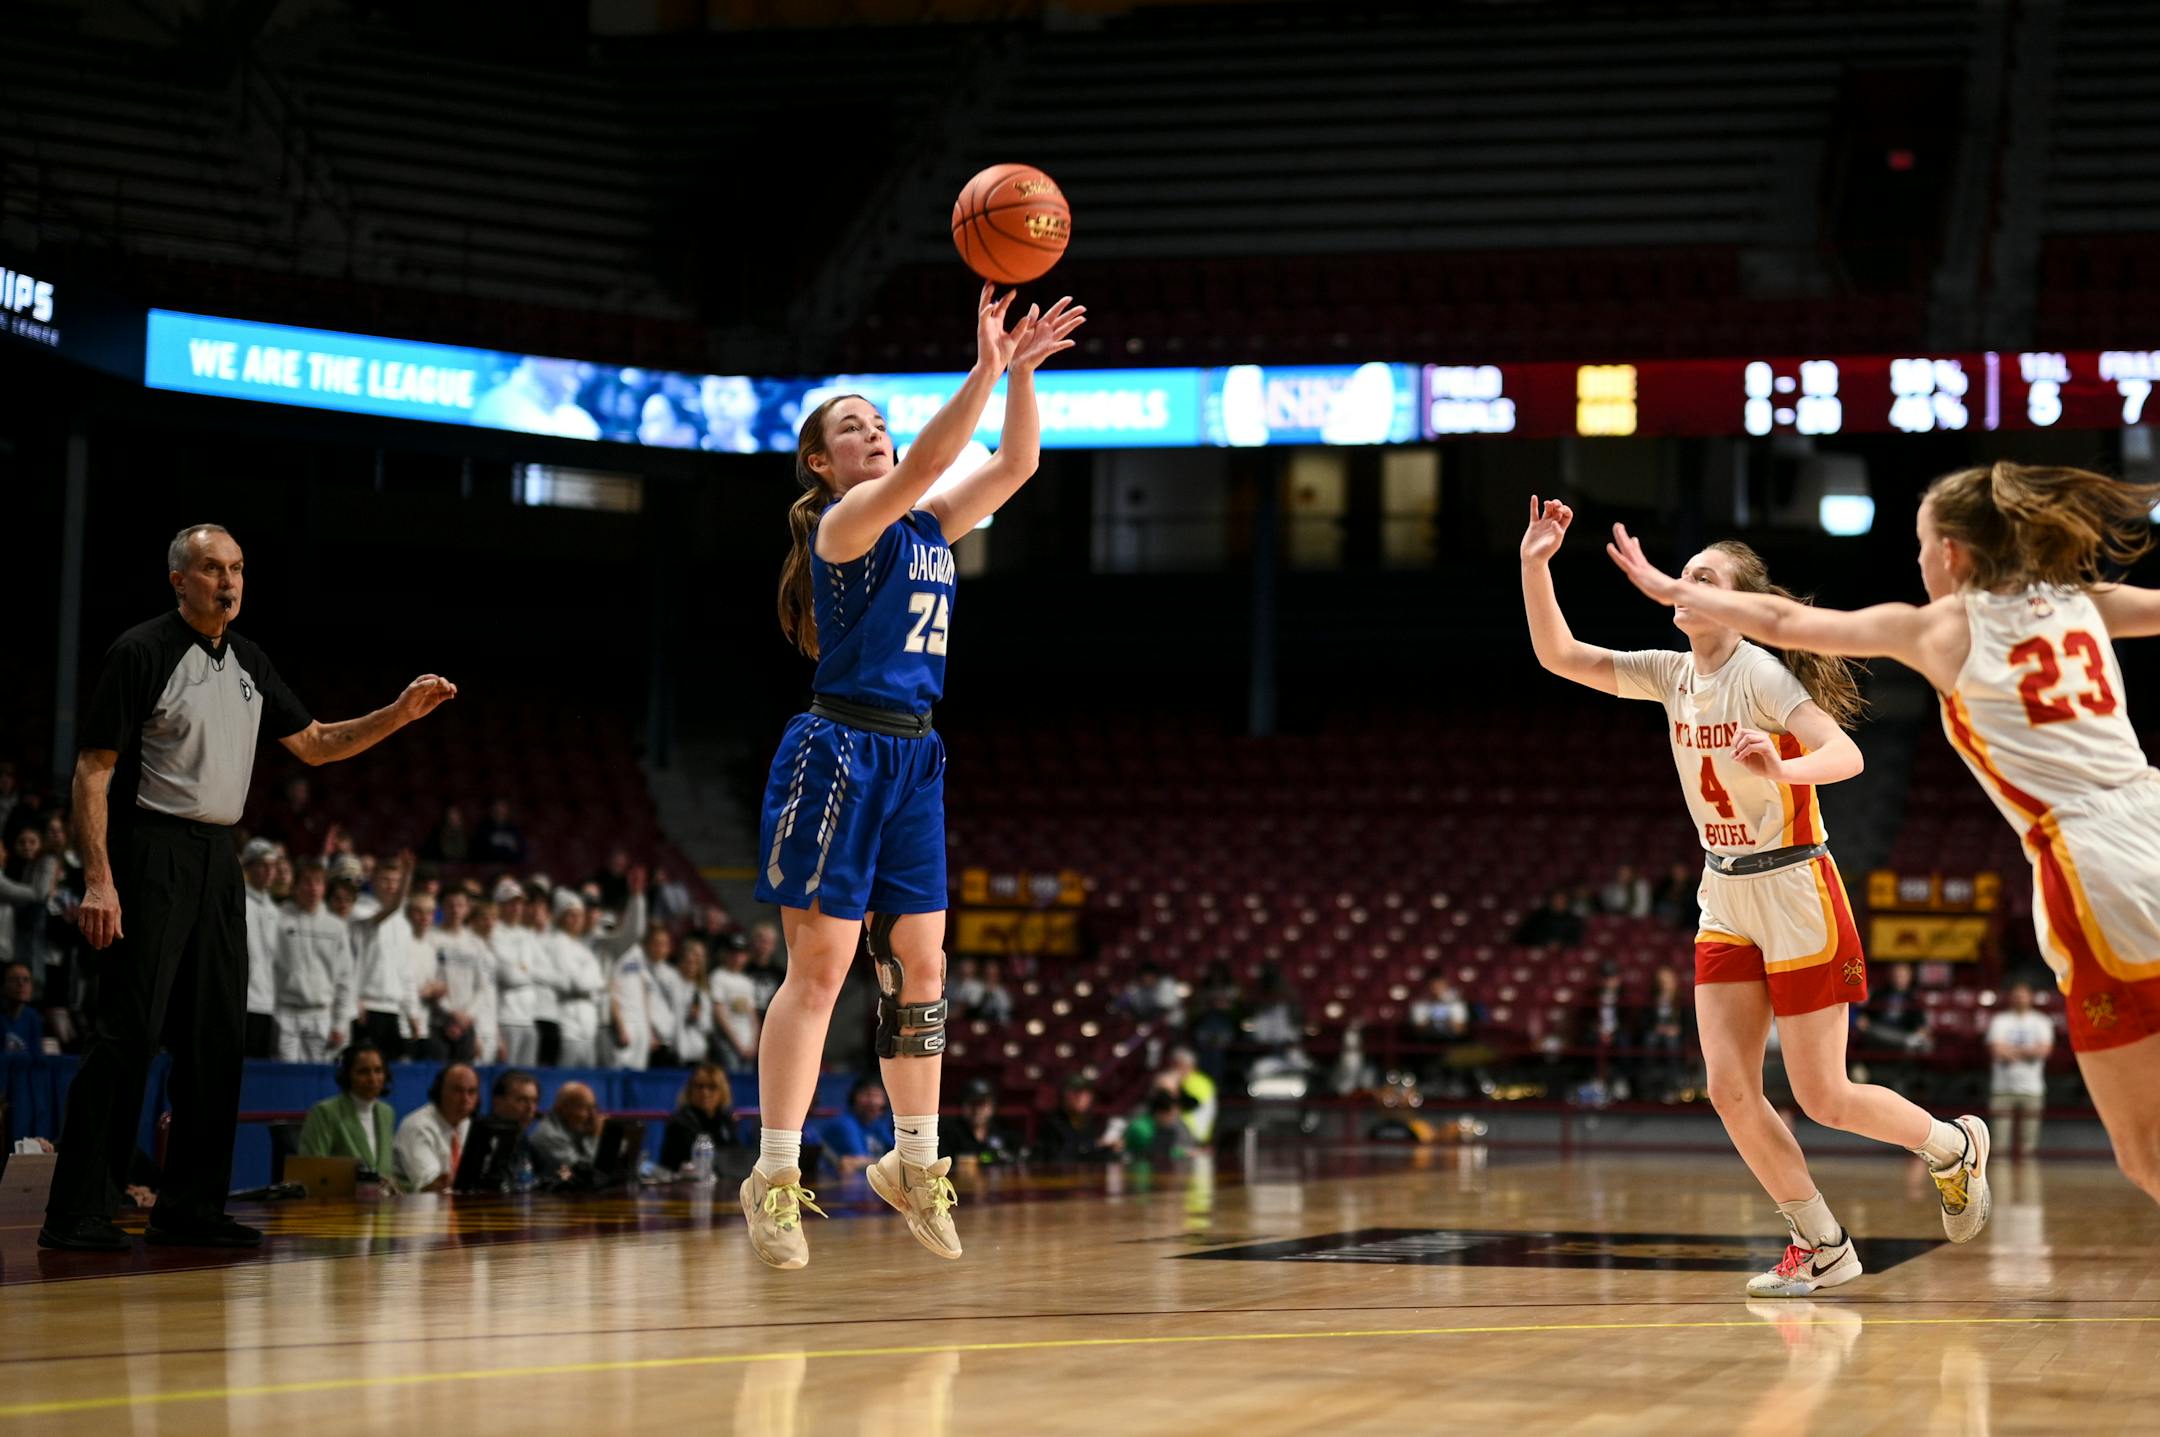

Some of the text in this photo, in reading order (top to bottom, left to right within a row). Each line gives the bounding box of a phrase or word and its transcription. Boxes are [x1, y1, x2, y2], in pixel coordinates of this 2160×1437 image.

[189, 338, 476, 410] WE ARE THE LEAGUE
[2008, 630, 2118, 728] 23
[1700, 756, 1735, 819] 4
[1705, 823, 1757, 847] BUHL
